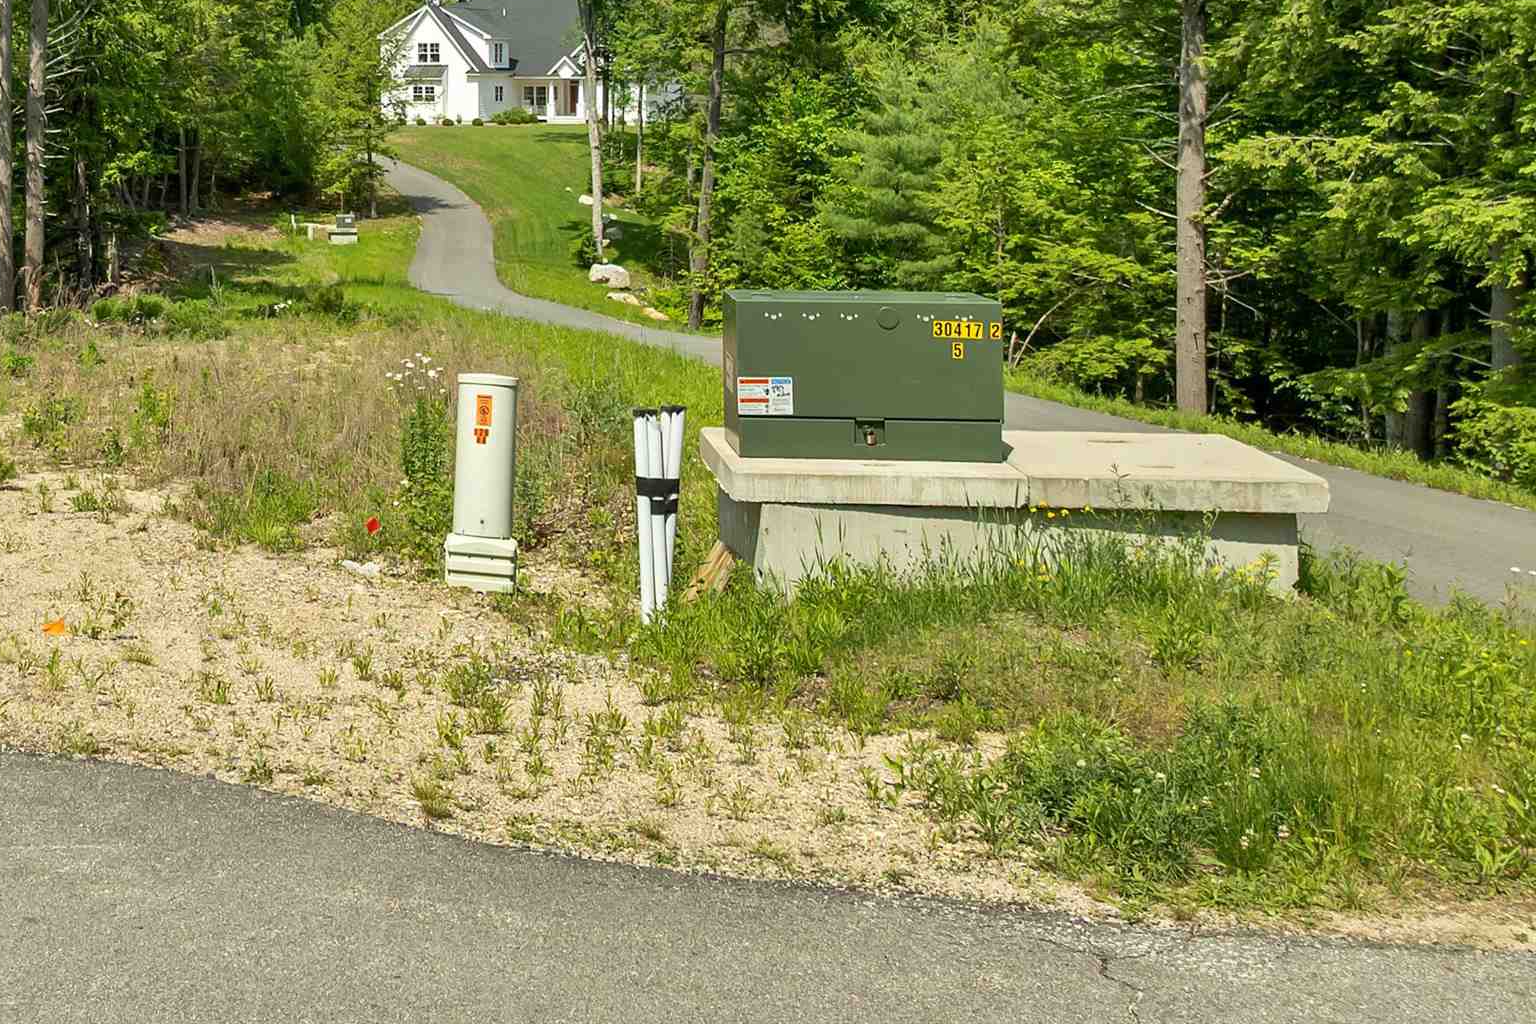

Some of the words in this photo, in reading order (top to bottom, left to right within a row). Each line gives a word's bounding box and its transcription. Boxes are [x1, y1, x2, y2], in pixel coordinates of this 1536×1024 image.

[934, 322, 982, 337] 30417
[991, 324, 1000, 338] 2
[954, 343, 962, 357] 5
